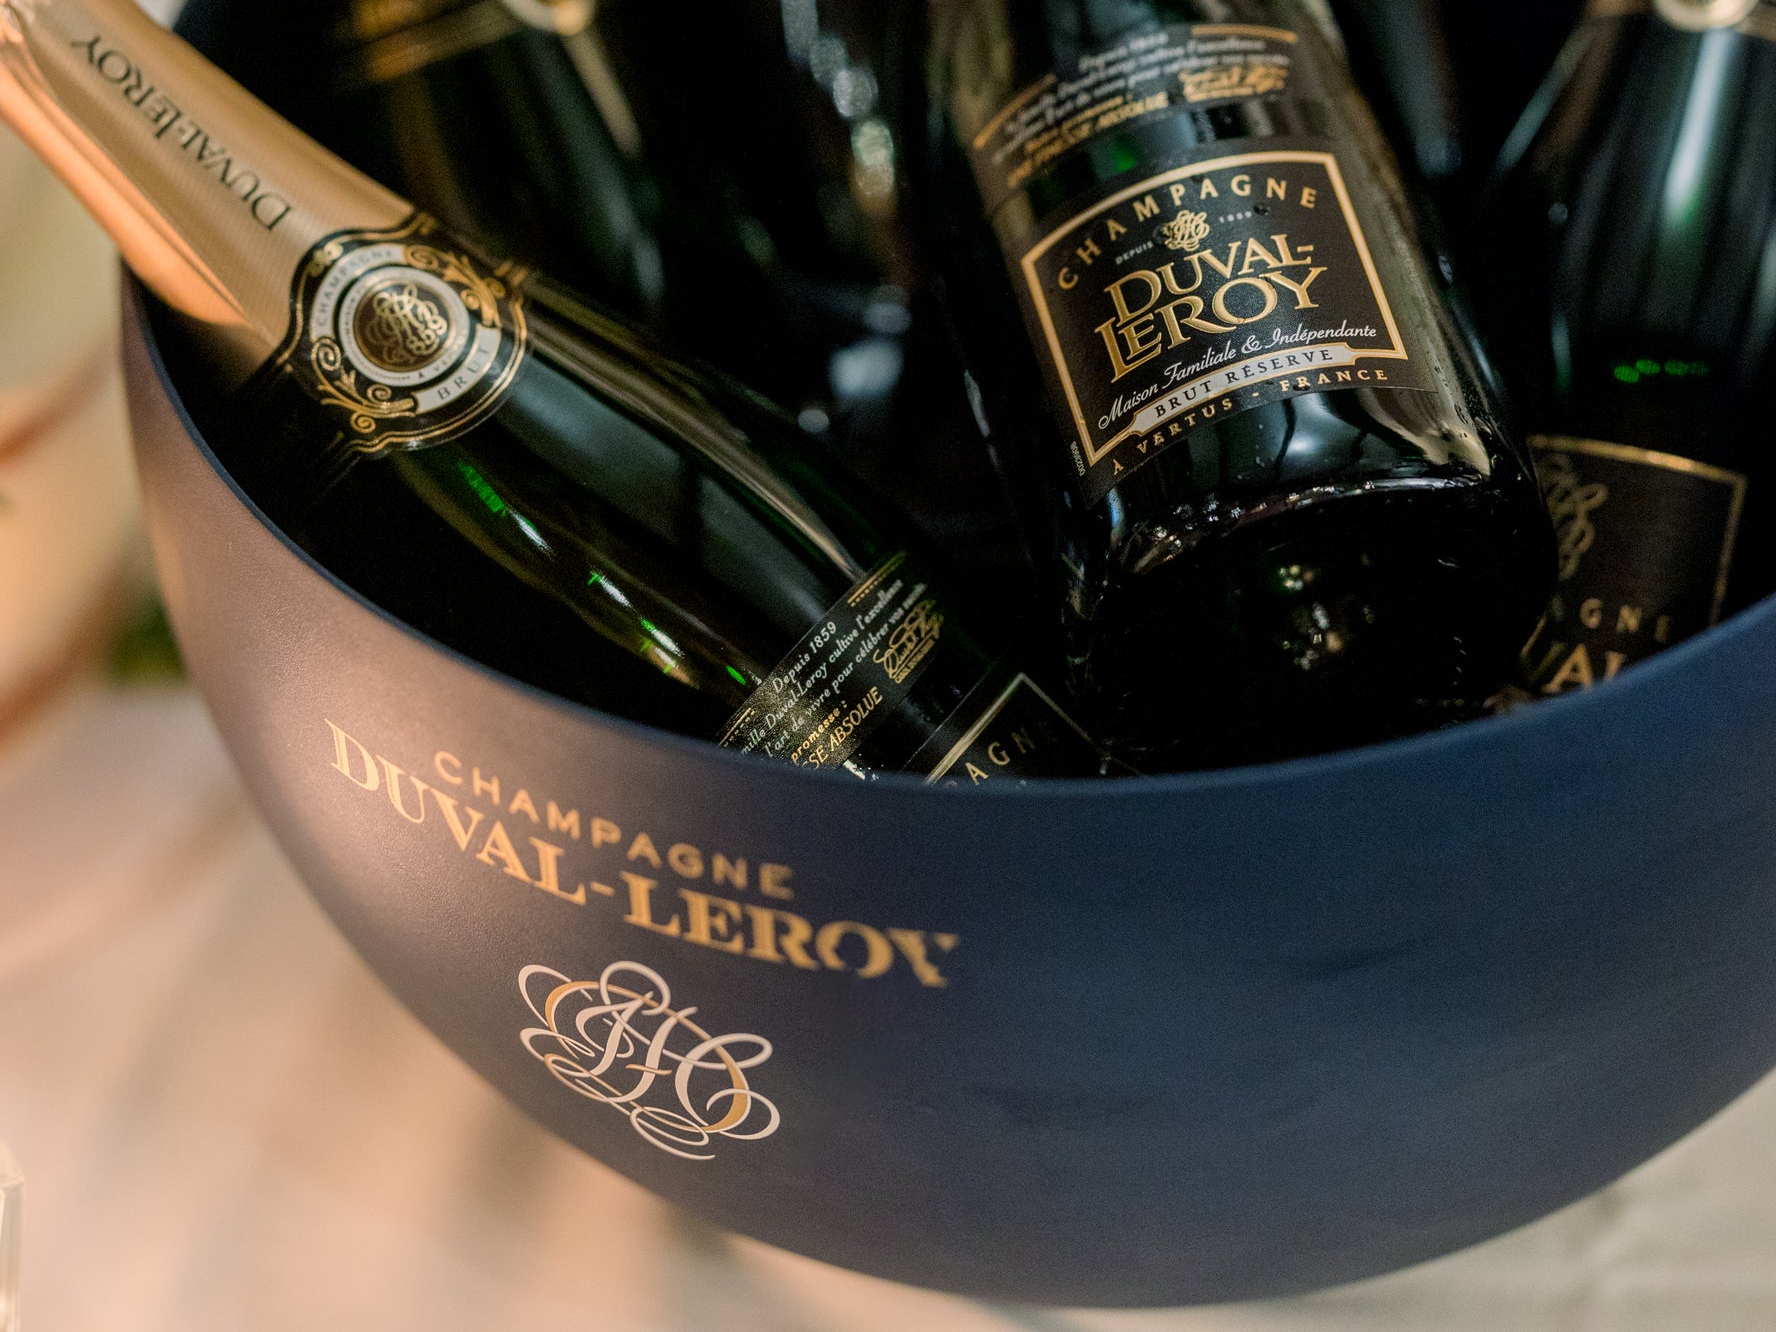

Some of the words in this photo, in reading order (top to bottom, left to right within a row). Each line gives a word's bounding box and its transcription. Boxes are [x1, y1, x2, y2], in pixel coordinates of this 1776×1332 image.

[70, 35, 292, 232] DUVAL-LEROY
[1058, 174, 1317, 290] CHAMPAGNE
[1115, 240, 1153, 265] DEPUIS
[1104, 233, 1314, 327] DUVAL-
[1094, 267, 1328, 383] LEROY
[437, 347, 490, 400] BRUT
[1098, 384, 1158, 429] Maison
[1162, 340, 1236, 389] Familiale
[1242, 335, 1263, 354] &
[1264, 320, 1377, 349] Indépendante
[1137, 397, 1233, 454] VERTUS
[1280, 369, 1388, 392] FRANCE
[1154, 379, 1212, 418] BRUT
[1225, 349, 1333, 384] RÉSERVE
[765, 663, 828, 728] Duval-Leroy
[829, 629, 859, 664] cultive
[772, 654, 810, 694] Depuis
[810, 621, 837, 654] 1859
[791, 714, 807, 732] de
[805, 688, 831, 716] vivre
[832, 662, 854, 694] pour
[791, 706, 841, 764] promesse
[828, 685, 884, 751] ABSOLUE
[324, 717, 960, 988] DUVAL-LEROY
[435, 750, 795, 901] CHAMPAGNE
